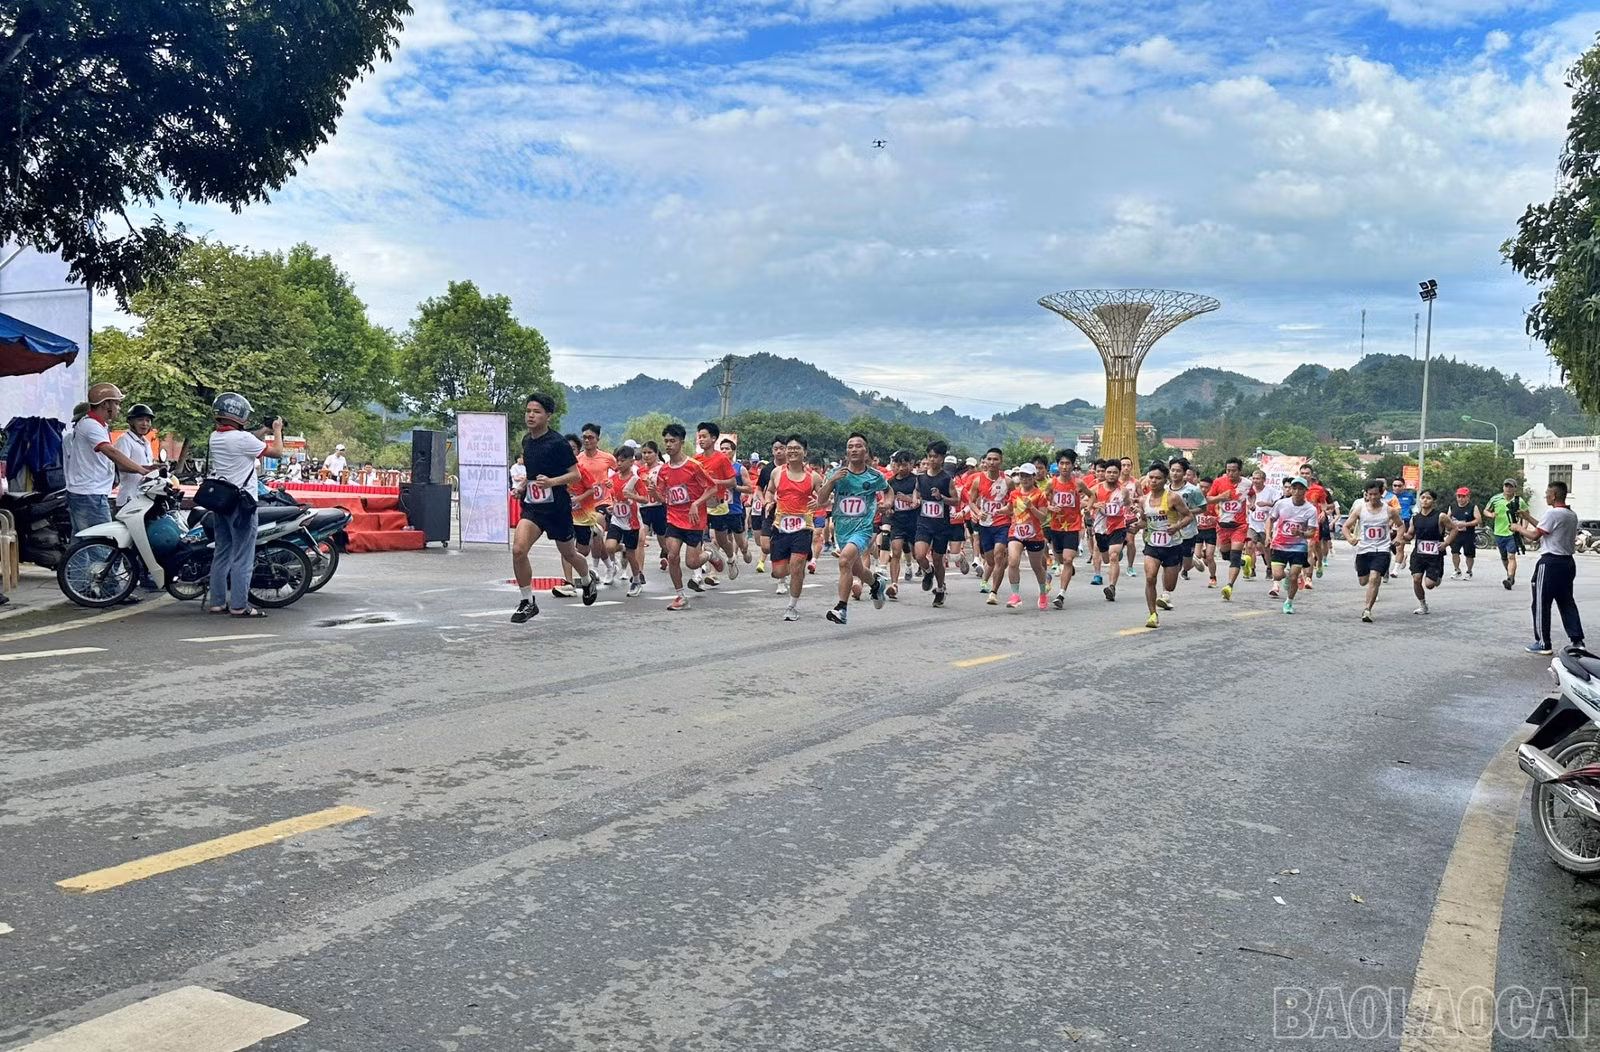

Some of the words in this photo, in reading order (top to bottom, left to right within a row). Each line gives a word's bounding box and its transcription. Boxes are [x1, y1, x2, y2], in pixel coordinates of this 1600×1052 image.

[1056, 493, 1072, 506] 183
[616, 504, 628, 516] 10
[842, 499, 862, 513] 177
[924, 503, 941, 515] 110
[1224, 502, 1238, 511] 82
[1152, 532, 1167, 544] 171
[1368, 528, 1382, 538] 01
[1421, 543, 1435, 551] 197
